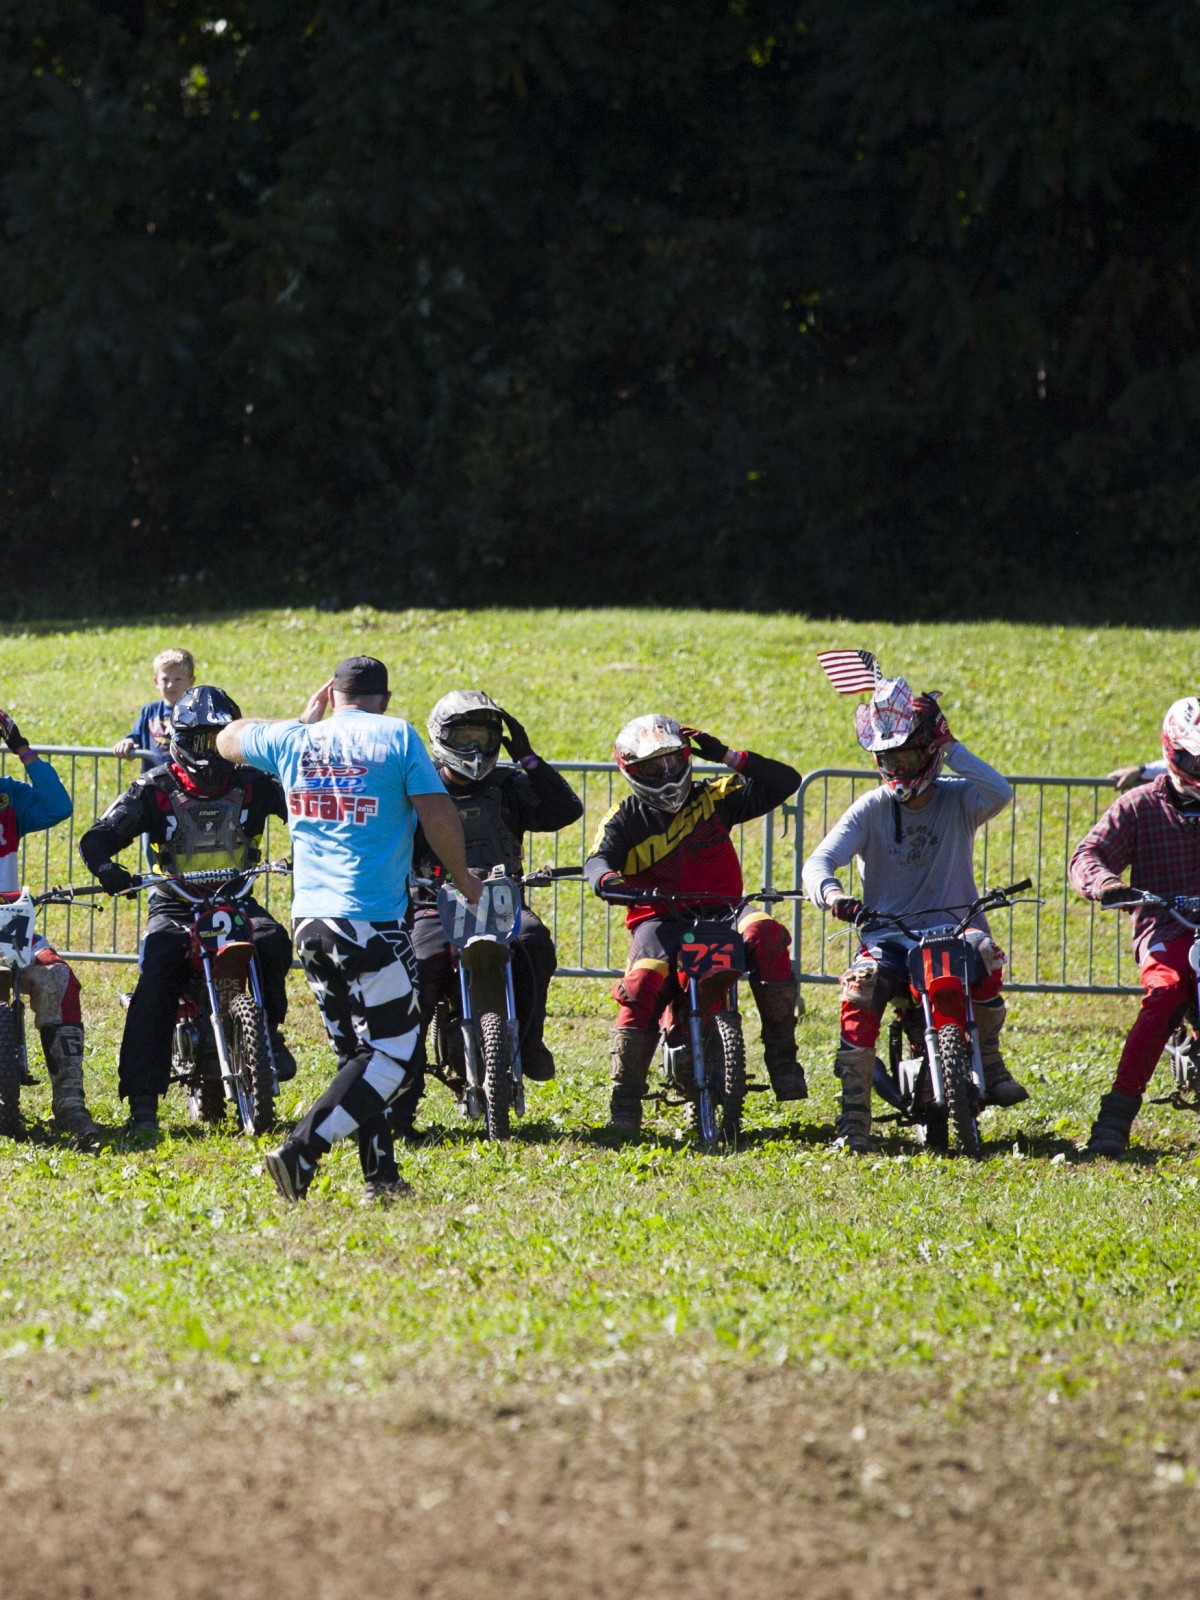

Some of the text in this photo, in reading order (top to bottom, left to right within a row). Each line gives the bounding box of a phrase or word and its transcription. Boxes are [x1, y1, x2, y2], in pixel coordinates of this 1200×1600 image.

[183, 867, 235, 880] RENTHAL
[212, 910, 236, 950] 2
[681, 943, 734, 973] 75
